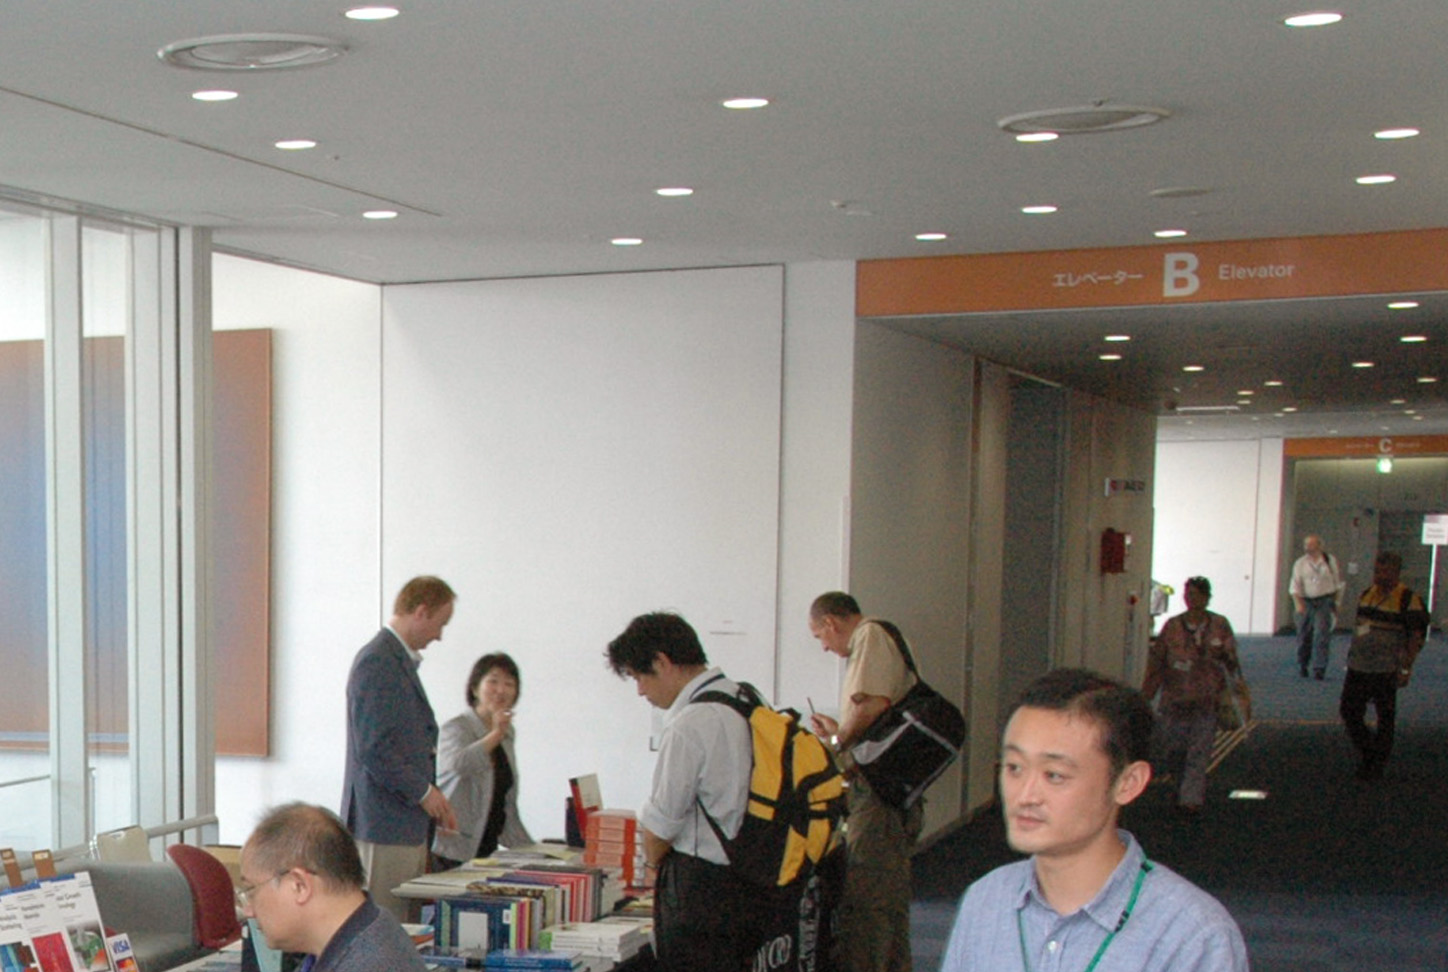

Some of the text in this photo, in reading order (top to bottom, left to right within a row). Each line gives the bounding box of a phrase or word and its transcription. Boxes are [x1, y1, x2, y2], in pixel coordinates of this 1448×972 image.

[1053, 270, 1143, 288] エレベーター
[1163, 252, 1200, 297] B
[1218, 263, 1294, 280] Elevator
[1378, 438, 1392, 453] C
[113, 939, 130, 954] VISA
